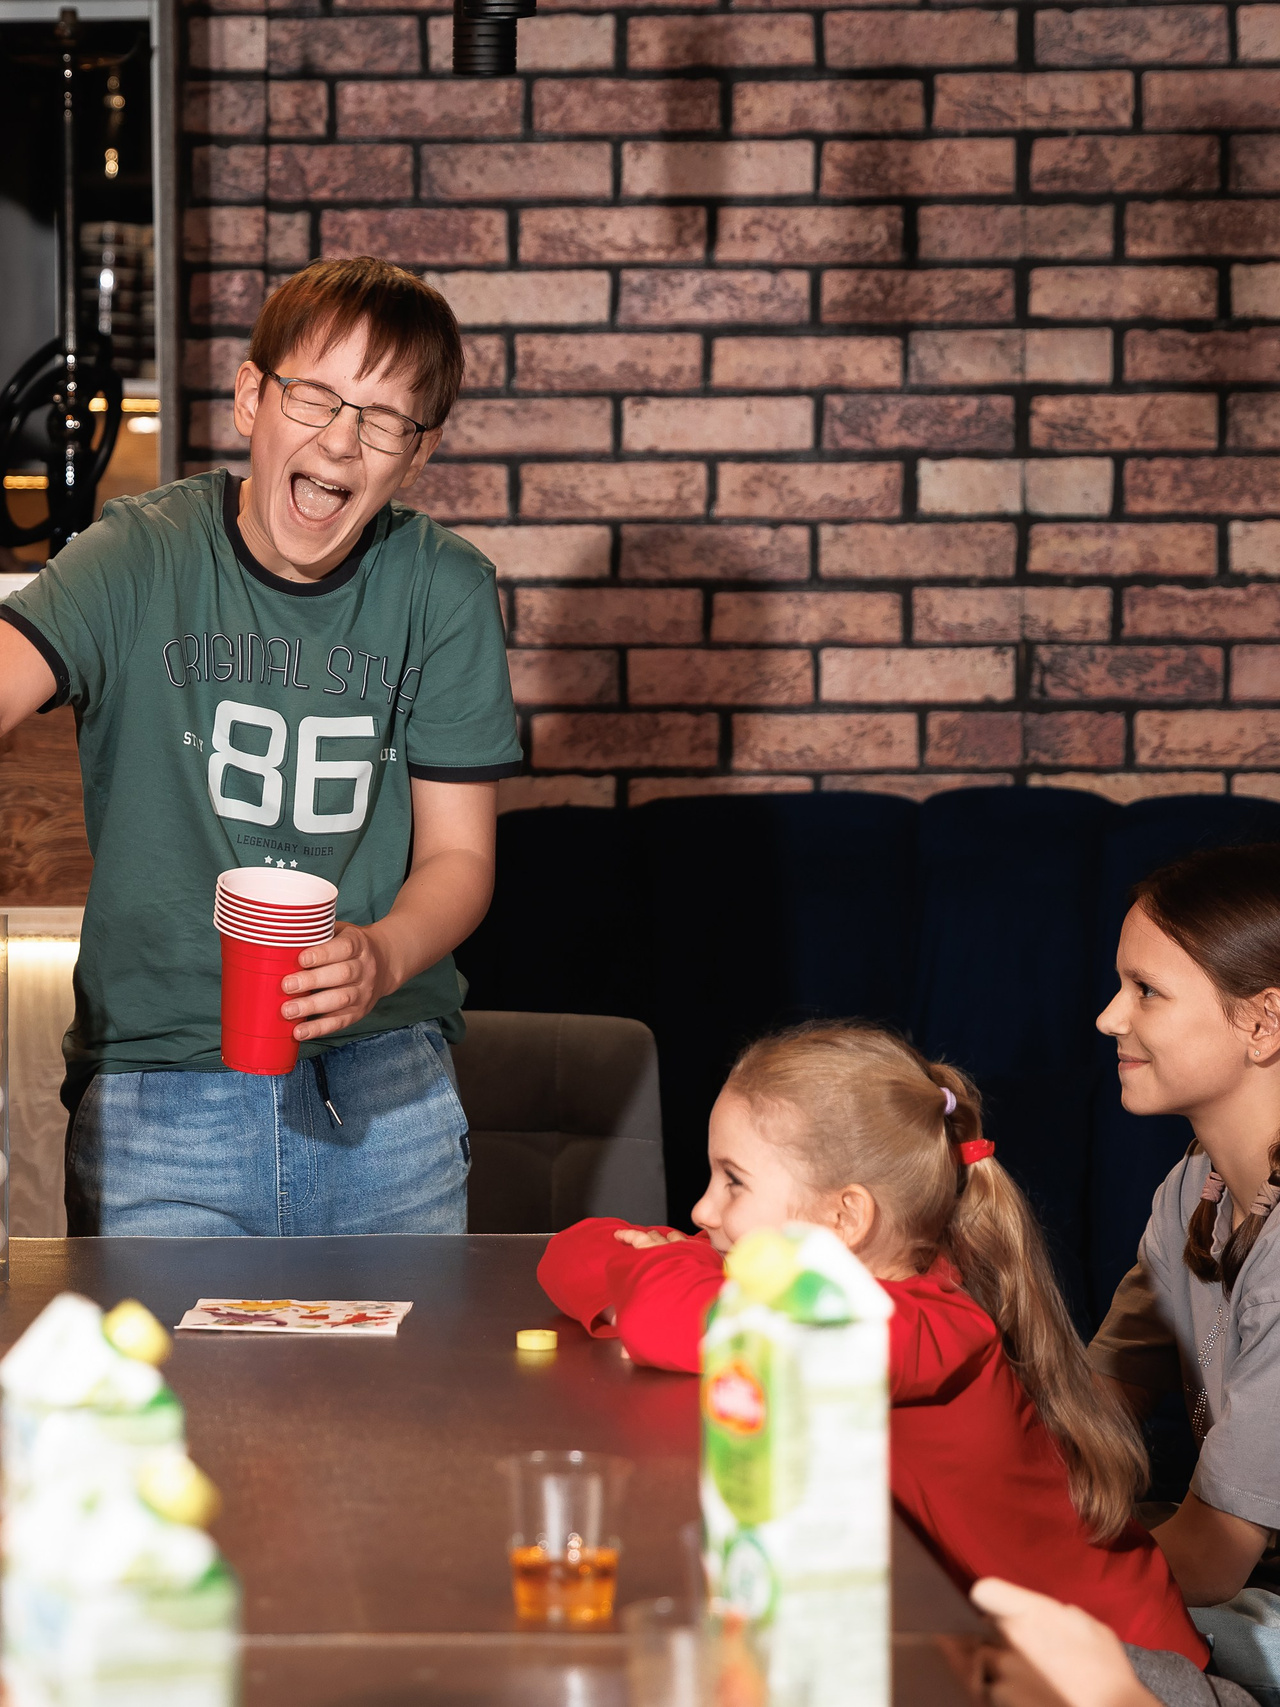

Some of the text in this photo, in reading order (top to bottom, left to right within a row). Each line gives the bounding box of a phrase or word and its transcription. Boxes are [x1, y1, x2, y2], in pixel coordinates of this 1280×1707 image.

[162, 632, 310, 689] ORIGINAL
[207, 699, 380, 835] 86
[236, 833, 334, 857] LEGENDARY RIDER
